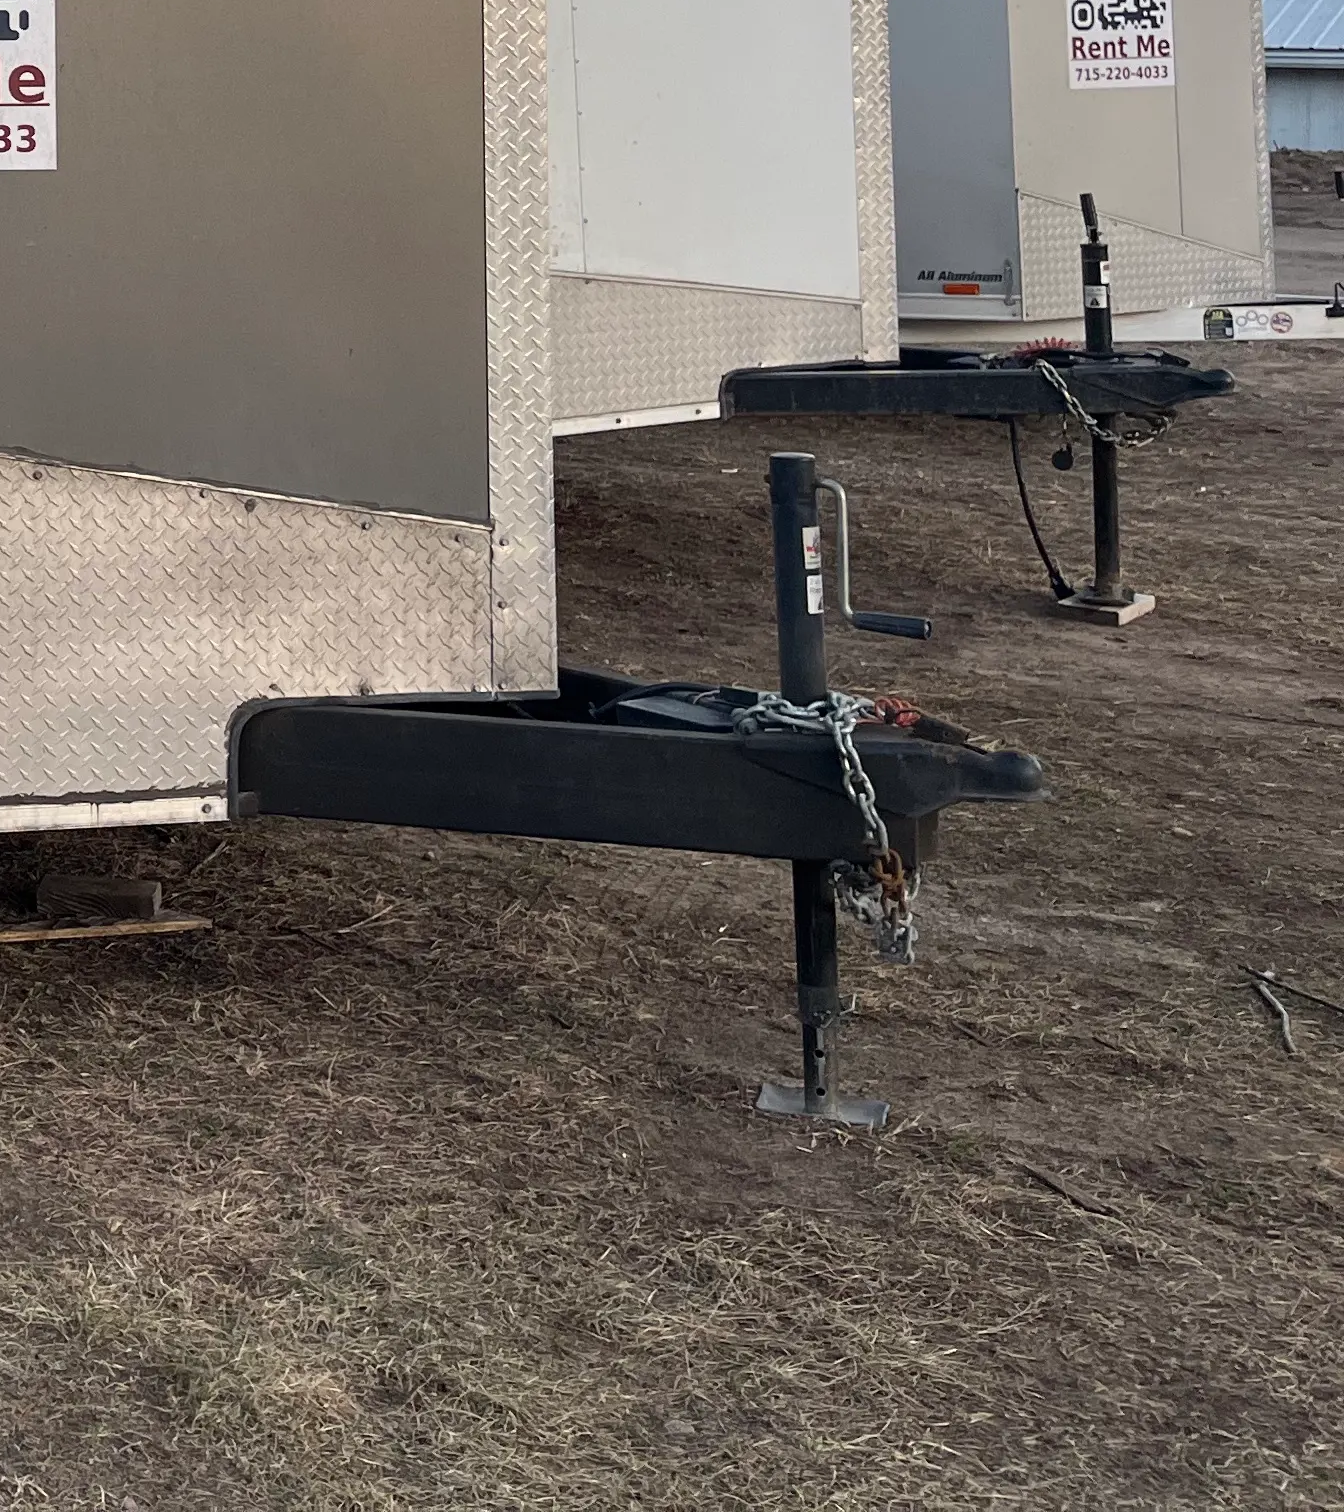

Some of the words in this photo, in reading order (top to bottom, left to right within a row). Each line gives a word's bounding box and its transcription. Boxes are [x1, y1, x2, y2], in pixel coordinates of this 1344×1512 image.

[1071, 37, 1128, 60] Rent
[1137, 35, 1170, 58] Me
[1075, 65, 1168, 81] 715-220-4033
[938, 271, 1002, 282] Aluminum
